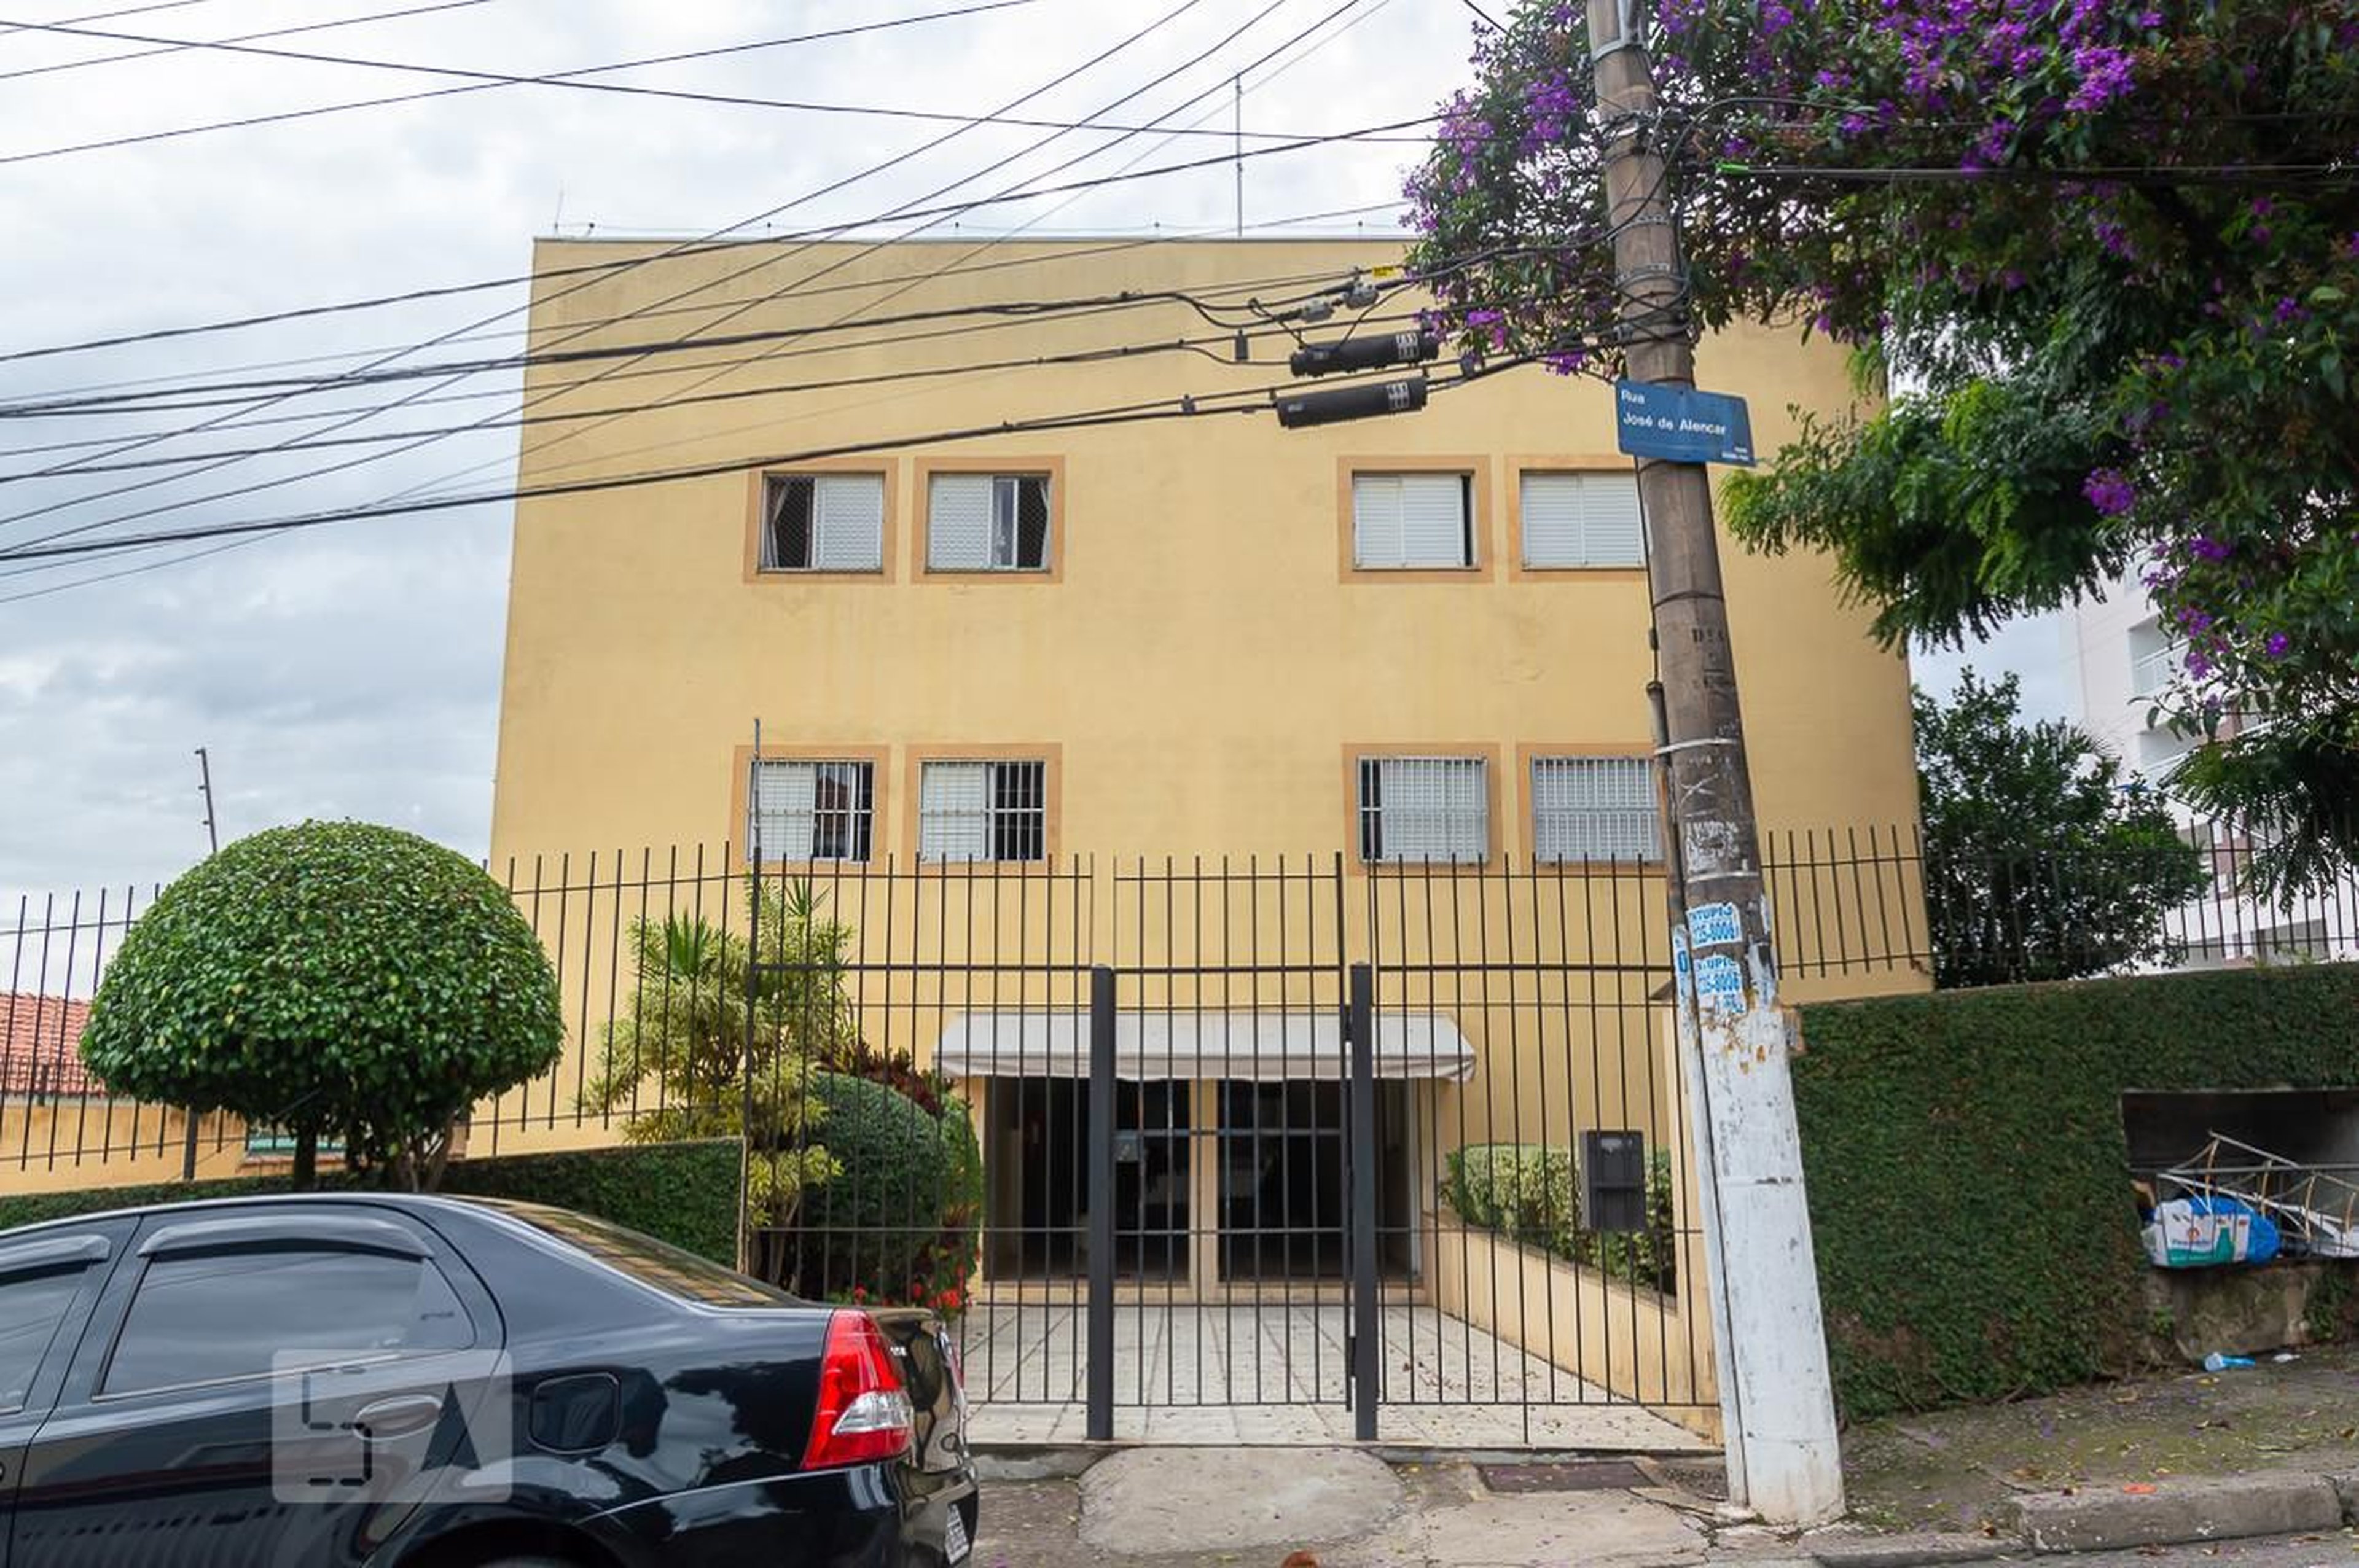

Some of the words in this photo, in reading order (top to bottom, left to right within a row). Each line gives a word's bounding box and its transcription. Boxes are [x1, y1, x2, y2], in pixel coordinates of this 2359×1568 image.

[1621, 389, 1645, 405] Rua
[1624, 413, 1653, 427] José
[1658, 417, 1673, 430] de
[1680, 419, 1726, 435] Alencar
